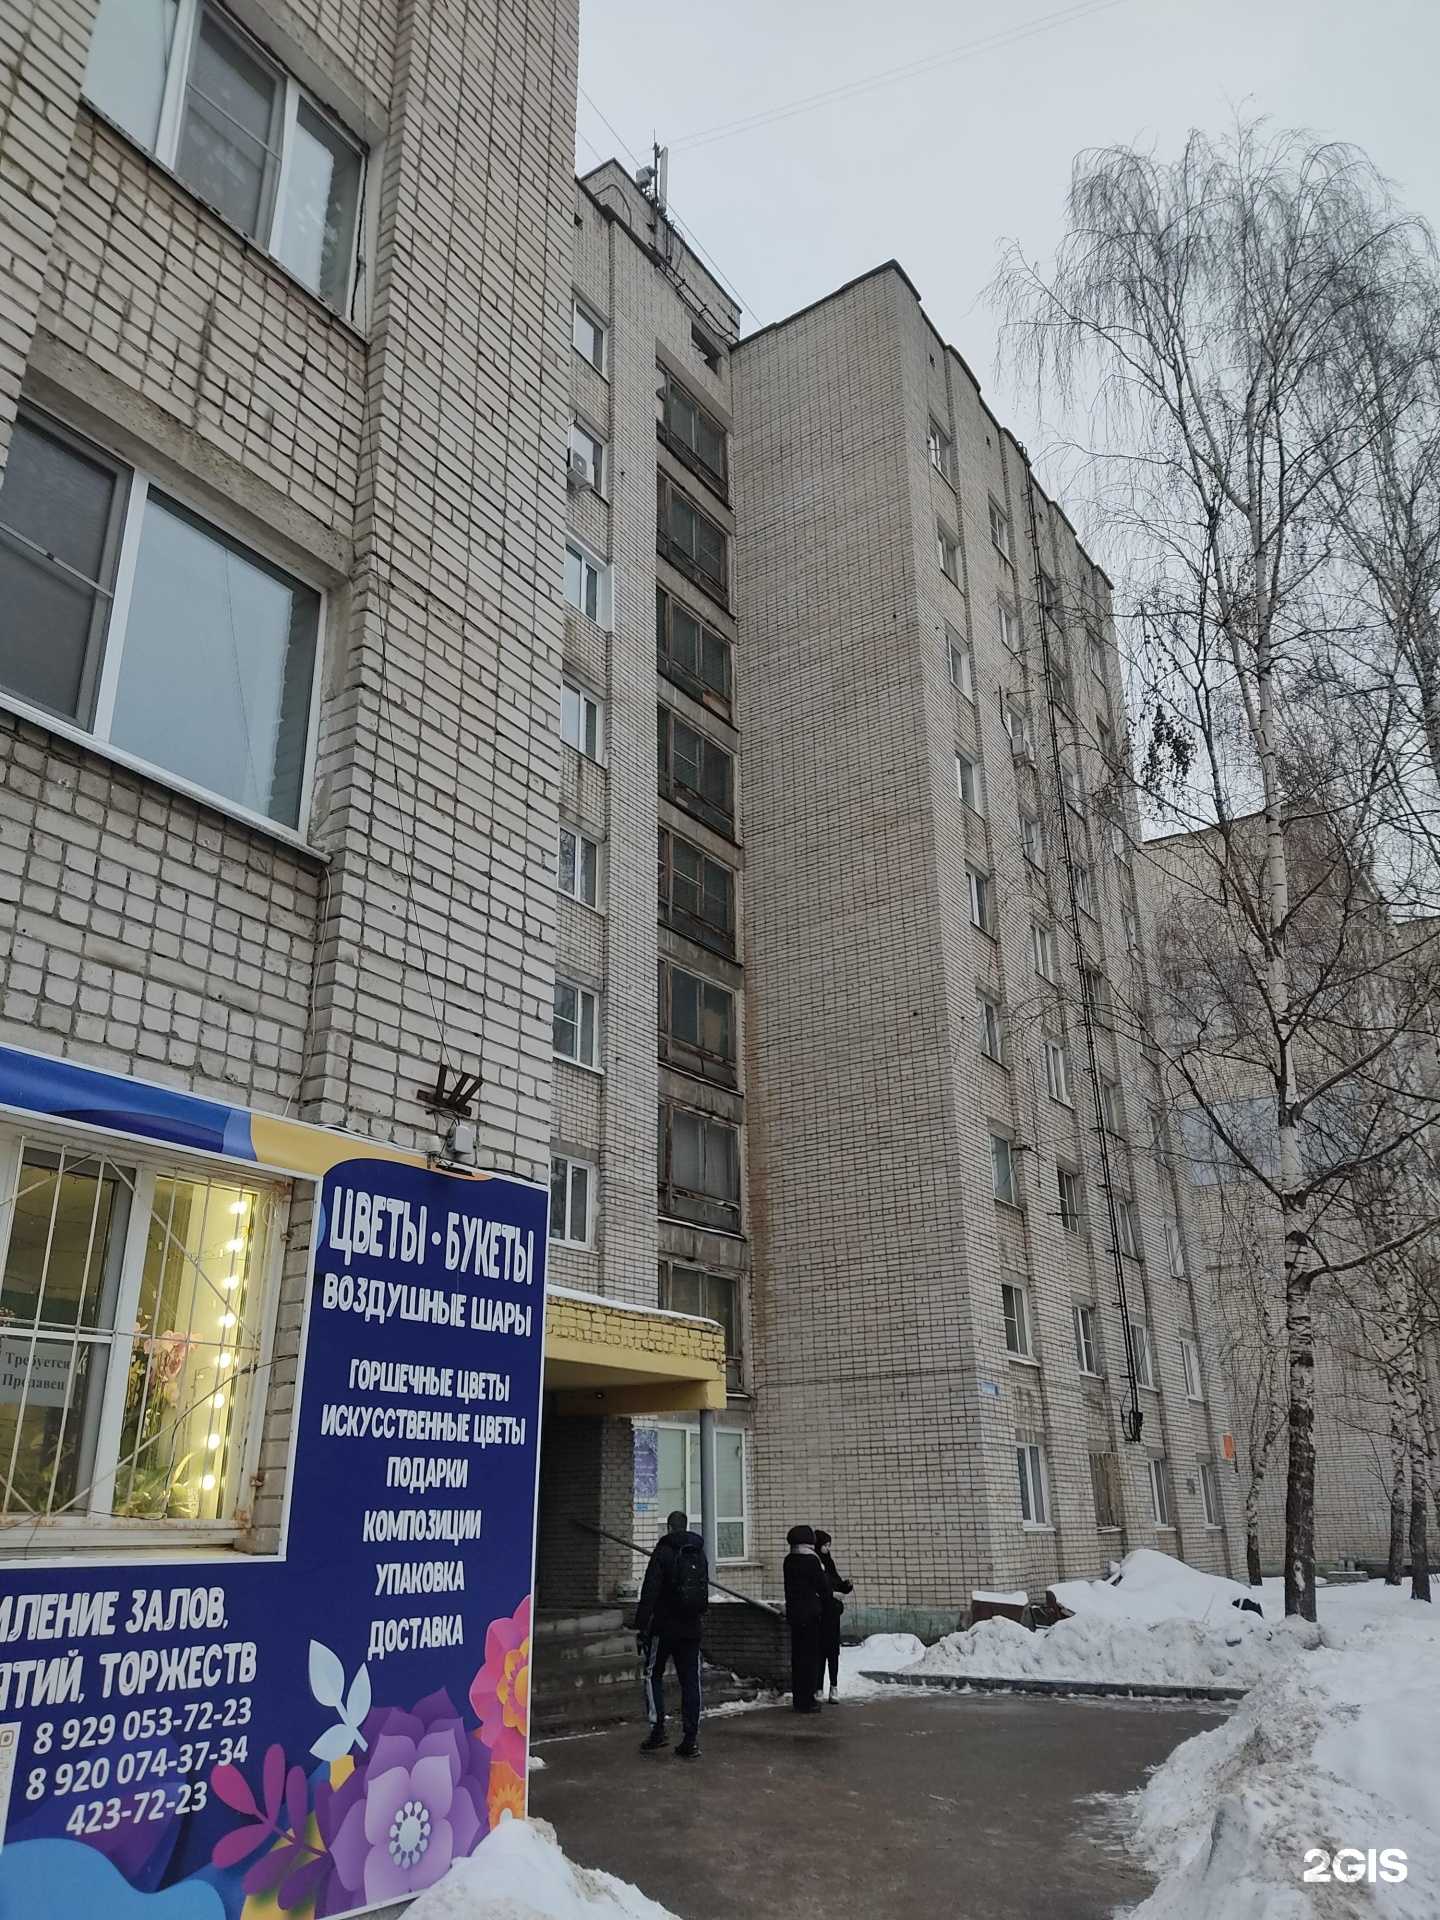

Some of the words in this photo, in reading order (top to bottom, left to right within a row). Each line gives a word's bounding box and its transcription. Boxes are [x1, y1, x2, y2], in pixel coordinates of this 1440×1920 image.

[329, 1186, 427, 1265] ЦВЕТЫ
[445, 1211, 534, 1285] БУКЕТЫ
[322, 1273, 467, 1328] ВОЗДУШНЫЕ
[470, 1296, 531, 1337] ШАРЫ
[349, 1358, 453, 1397] ГОРШЕЧНЫЕ
[456, 1369, 510, 1404] ЦВЕТЫ
[320, 1403, 470, 1442] ИСКУССТВЕННЫЕ
[473, 1414, 526, 1449] ЦВЕТЫ
[386, 1456, 469, 1493] ПОДАРКИ
[362, 1509, 482, 1546] КОМПОЗИЦИИ
[374, 1560, 465, 1596] УПАКОВКА
[125, 1586, 229, 1634] ЗАЛОВ,
[367, 1614, 464, 1661] ДОСТАВКА
[99, 1641, 257, 1698] ТОРЖЕСТВ
[32, 1722, 54, 1754] 8
[60, 1713, 116, 1750] 929
[122, 1696, 252, 1742] 053-72-23
[25, 1767, 47, 1800] 8
[53, 1757, 110, 1797] 920
[116, 1735, 248, 1785] 074-37-34
[66, 1781, 208, 1836] 423-72-23
